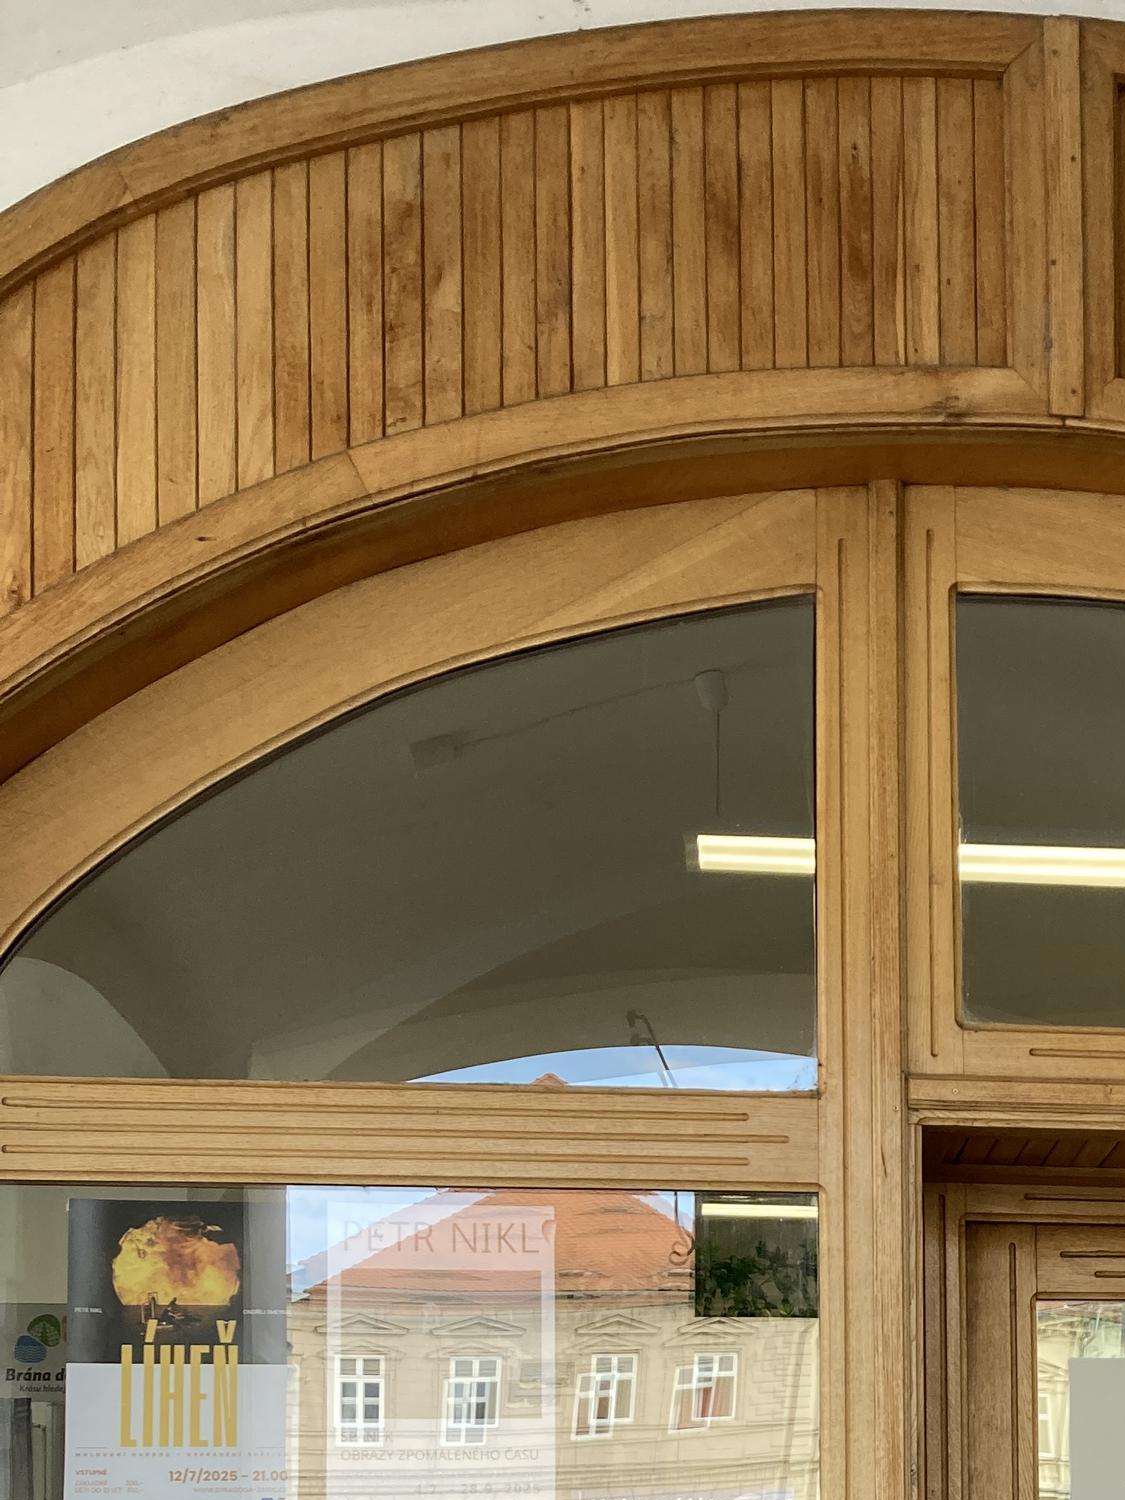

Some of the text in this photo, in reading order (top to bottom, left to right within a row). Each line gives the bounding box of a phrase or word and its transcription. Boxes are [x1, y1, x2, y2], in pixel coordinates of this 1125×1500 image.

[343, 1220, 540, 1254] PETR NIKL
[6, 1367, 51, 1381] Brána
[120, 1319, 239, 1447] LÍHEŇ
[340, 1446, 540, 1461] OBRAZY ZPOMALENÉHO ČASU
[168, 1468, 238, 1484] 12/7/2025
